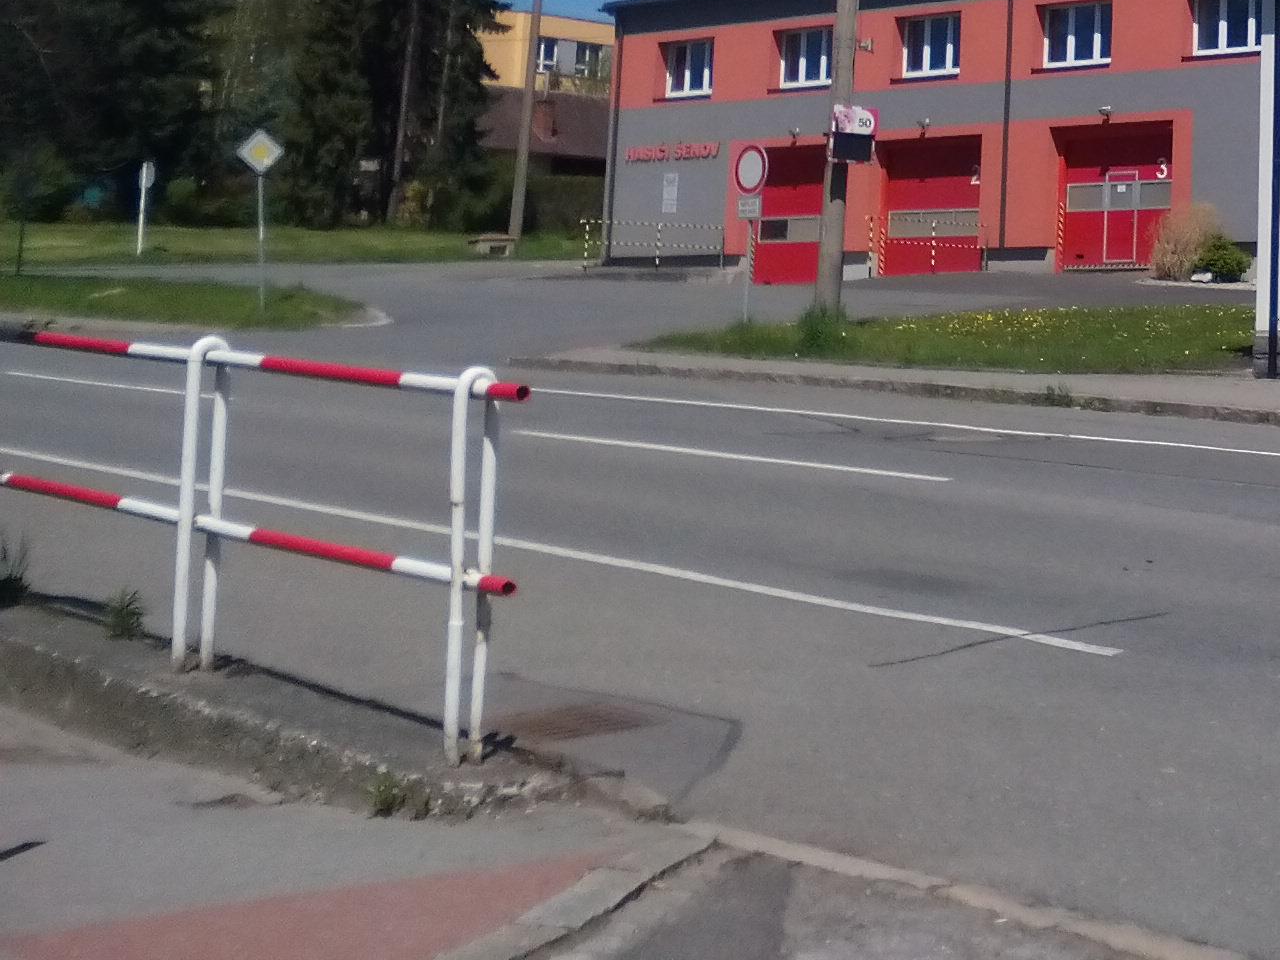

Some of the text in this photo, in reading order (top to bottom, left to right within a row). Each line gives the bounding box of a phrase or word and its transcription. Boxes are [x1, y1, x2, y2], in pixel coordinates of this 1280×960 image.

[858, 118, 872, 128] 50
[970, 164, 980, 185] 2
[1156, 157, 1168, 179] 3
